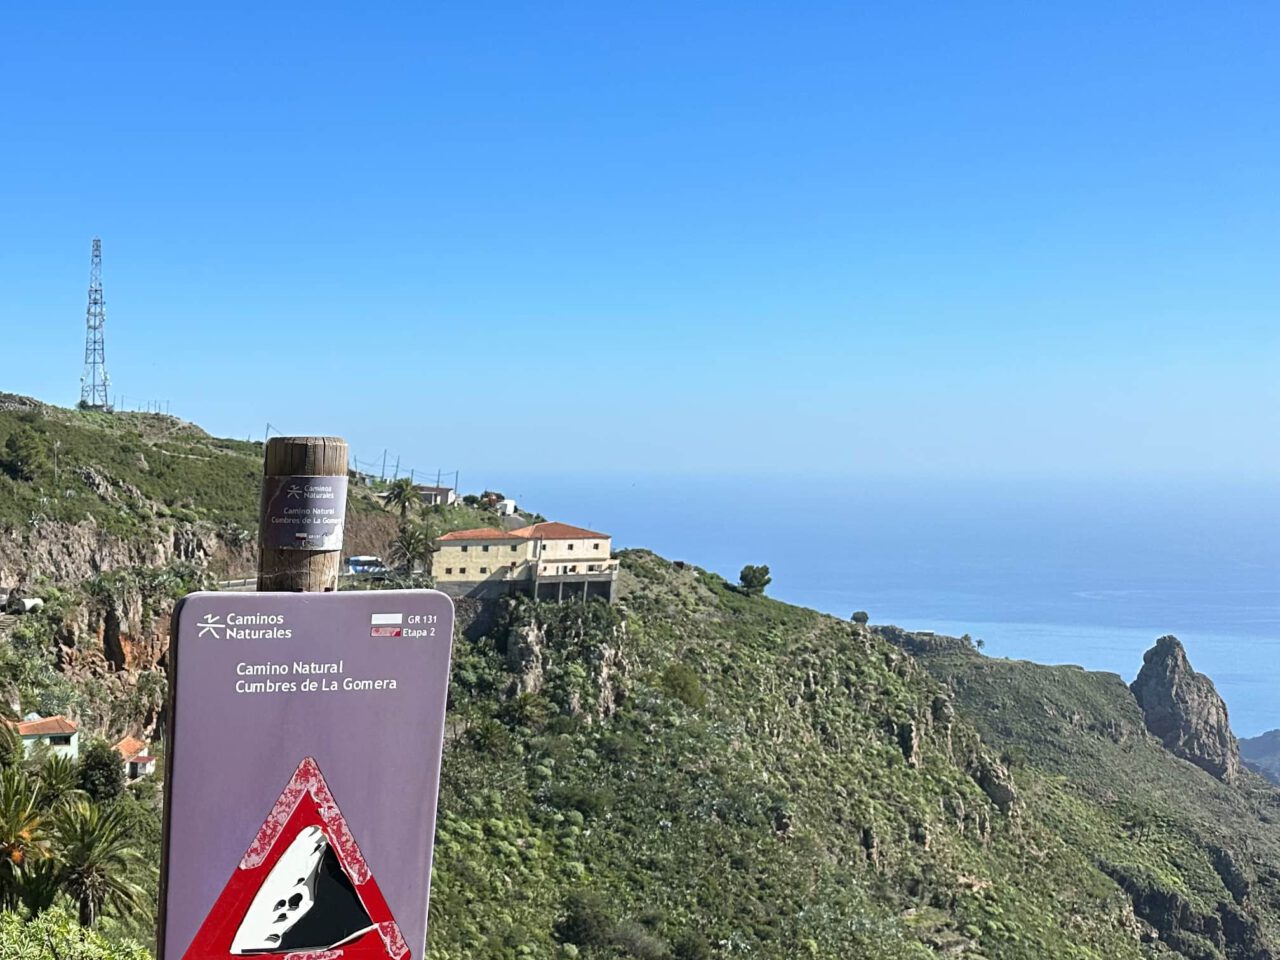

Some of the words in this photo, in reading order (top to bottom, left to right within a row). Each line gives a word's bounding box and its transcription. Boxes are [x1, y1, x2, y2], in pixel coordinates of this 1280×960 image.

[304, 484, 332, 492] Caminos
[303, 491, 335, 499] Naturales
[283, 507, 311, 515] Camino
[312, 507, 335, 515] Natural
[301, 516, 312, 524] de
[313, 516, 321, 524] La
[226, 612, 284, 625] Caminos
[407, 615, 421, 624] GR
[422, 614, 437, 624] 131
[226, 626, 292, 639] Naturales
[402, 628, 427, 638] Etapa
[429, 627, 436, 636] 2
[236, 661, 289, 675] Camino
[292, 660, 343, 674] Natural
[235, 679, 297, 693] Cumbres
[300, 678, 319, 691] de
[321, 678, 338, 691] La
[342, 676, 397, 690] Gomera
